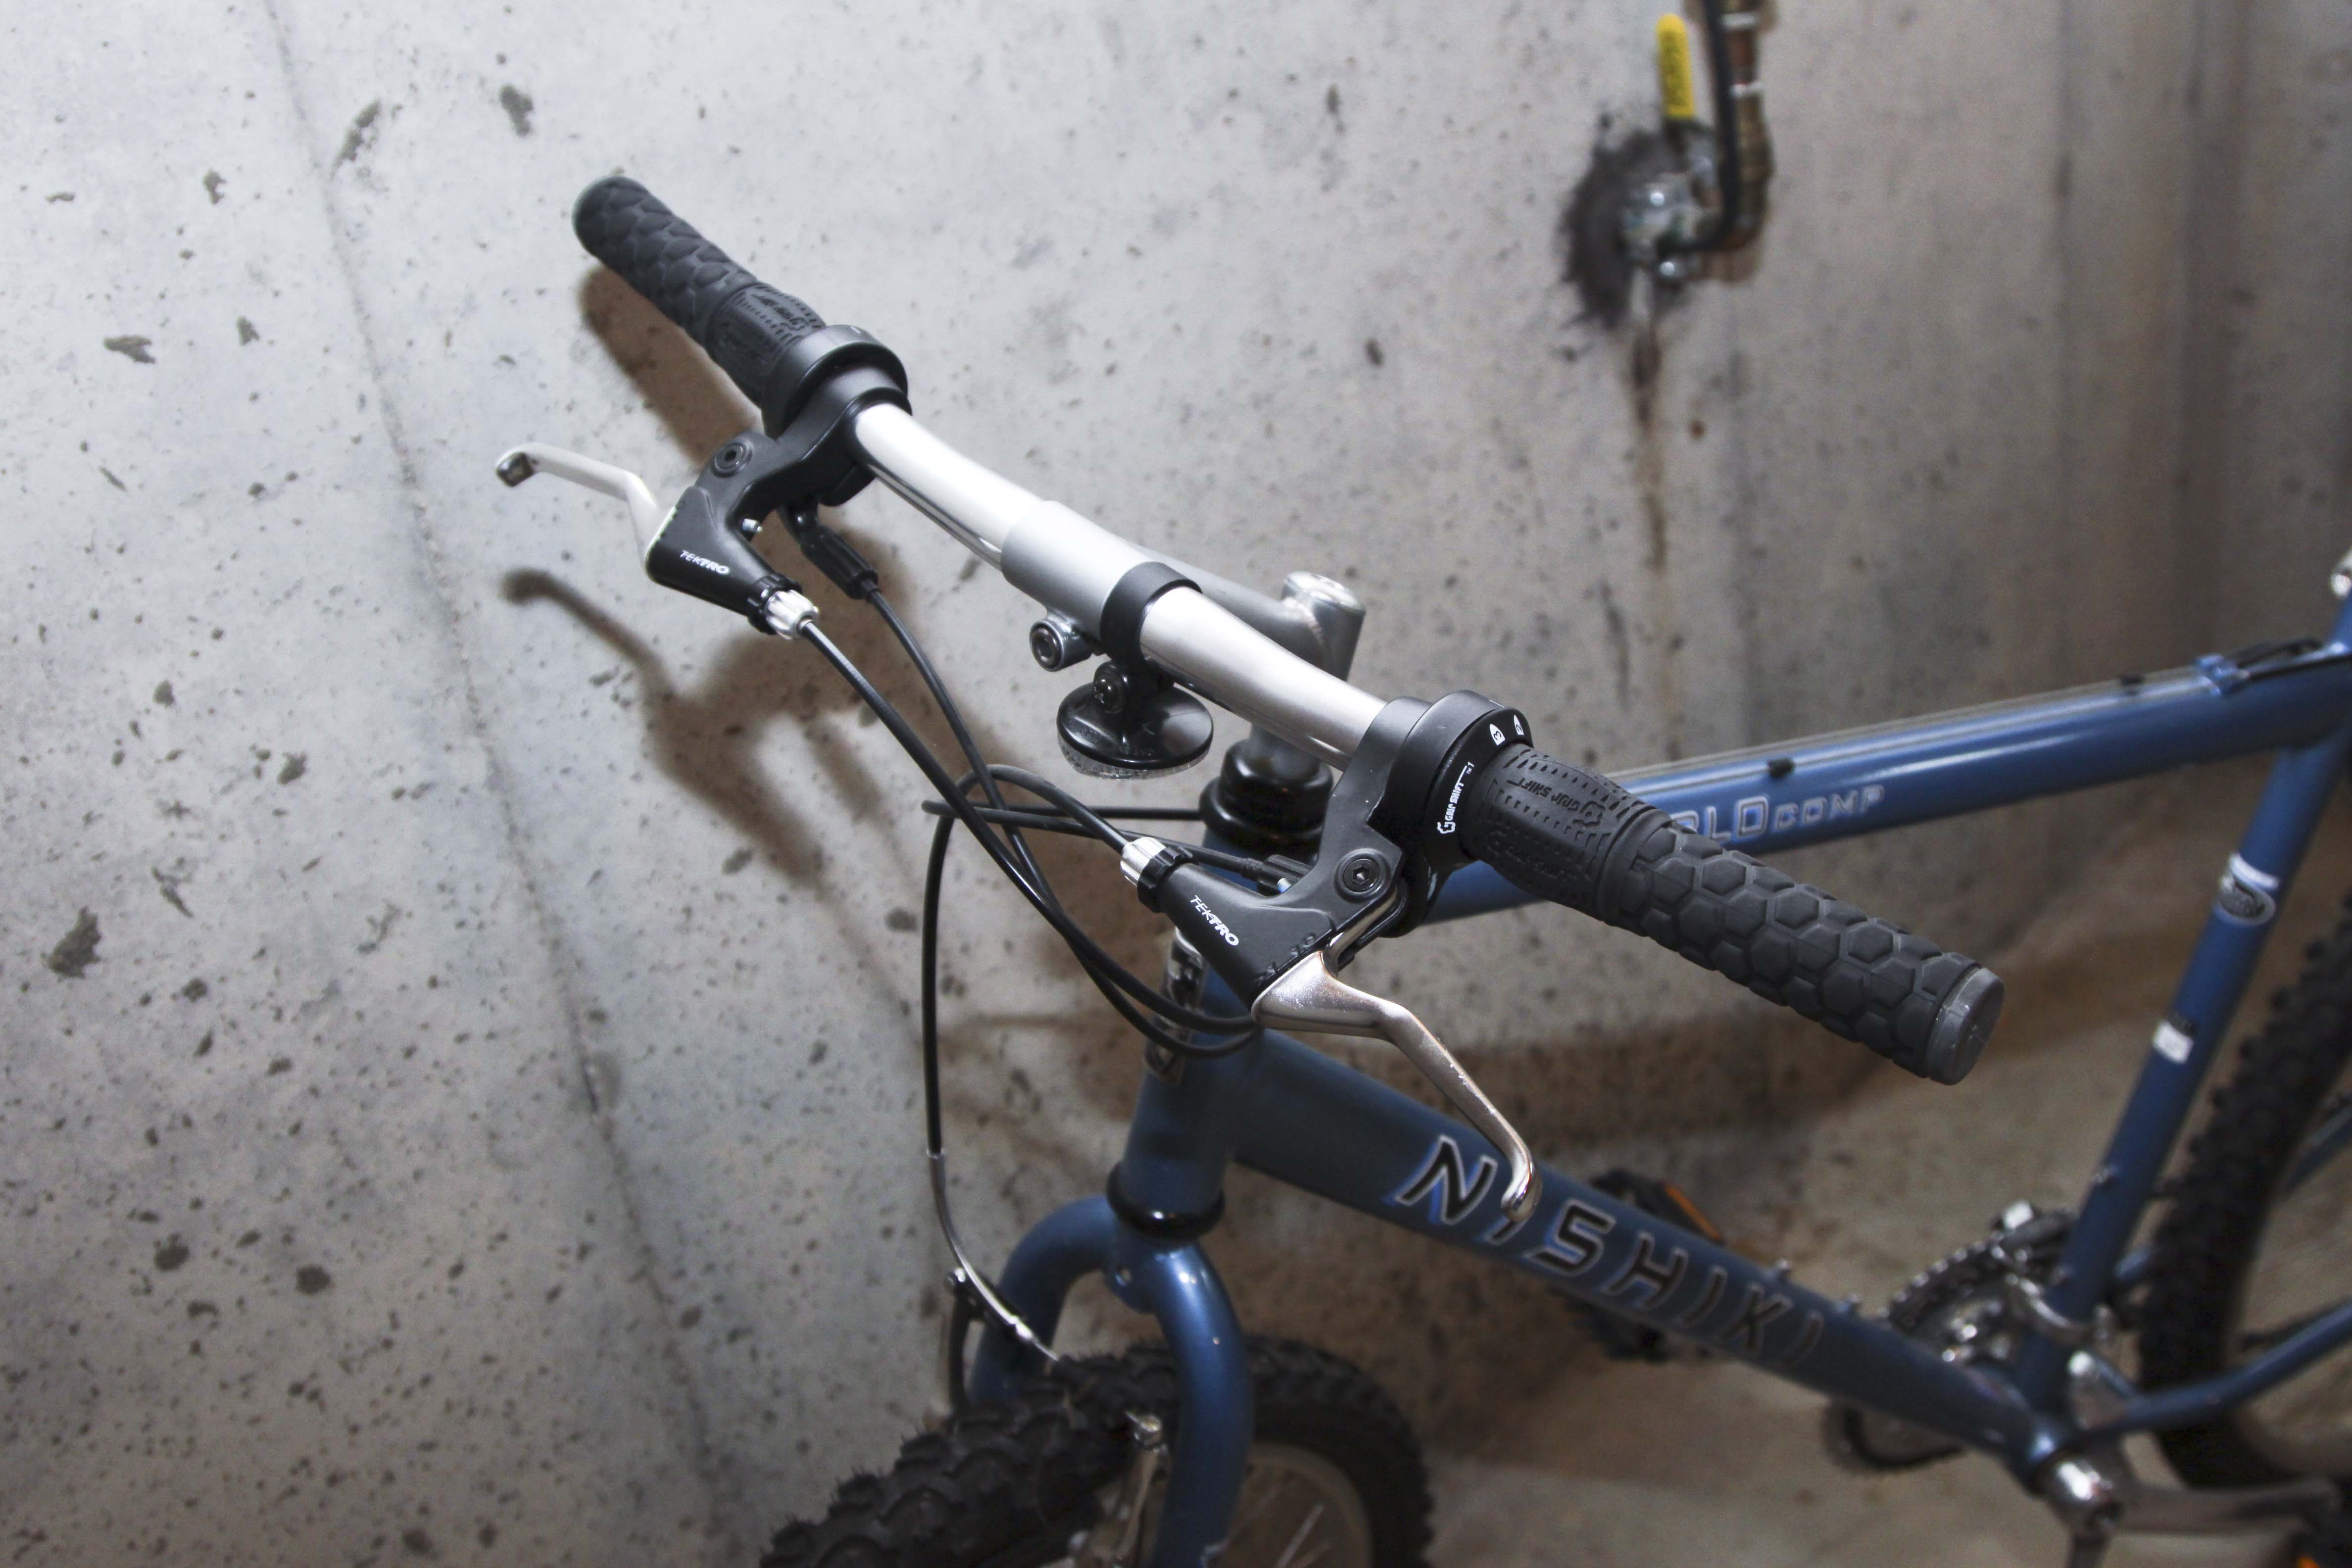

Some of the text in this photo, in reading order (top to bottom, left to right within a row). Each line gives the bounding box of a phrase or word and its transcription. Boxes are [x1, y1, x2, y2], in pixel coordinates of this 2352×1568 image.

[679, 550, 730, 575] TEKTRO
[1493, 731, 1502, 740] 3
[1506, 777, 1552, 798] SHIFT
[1190, 894, 1239, 946] TEKTRO
